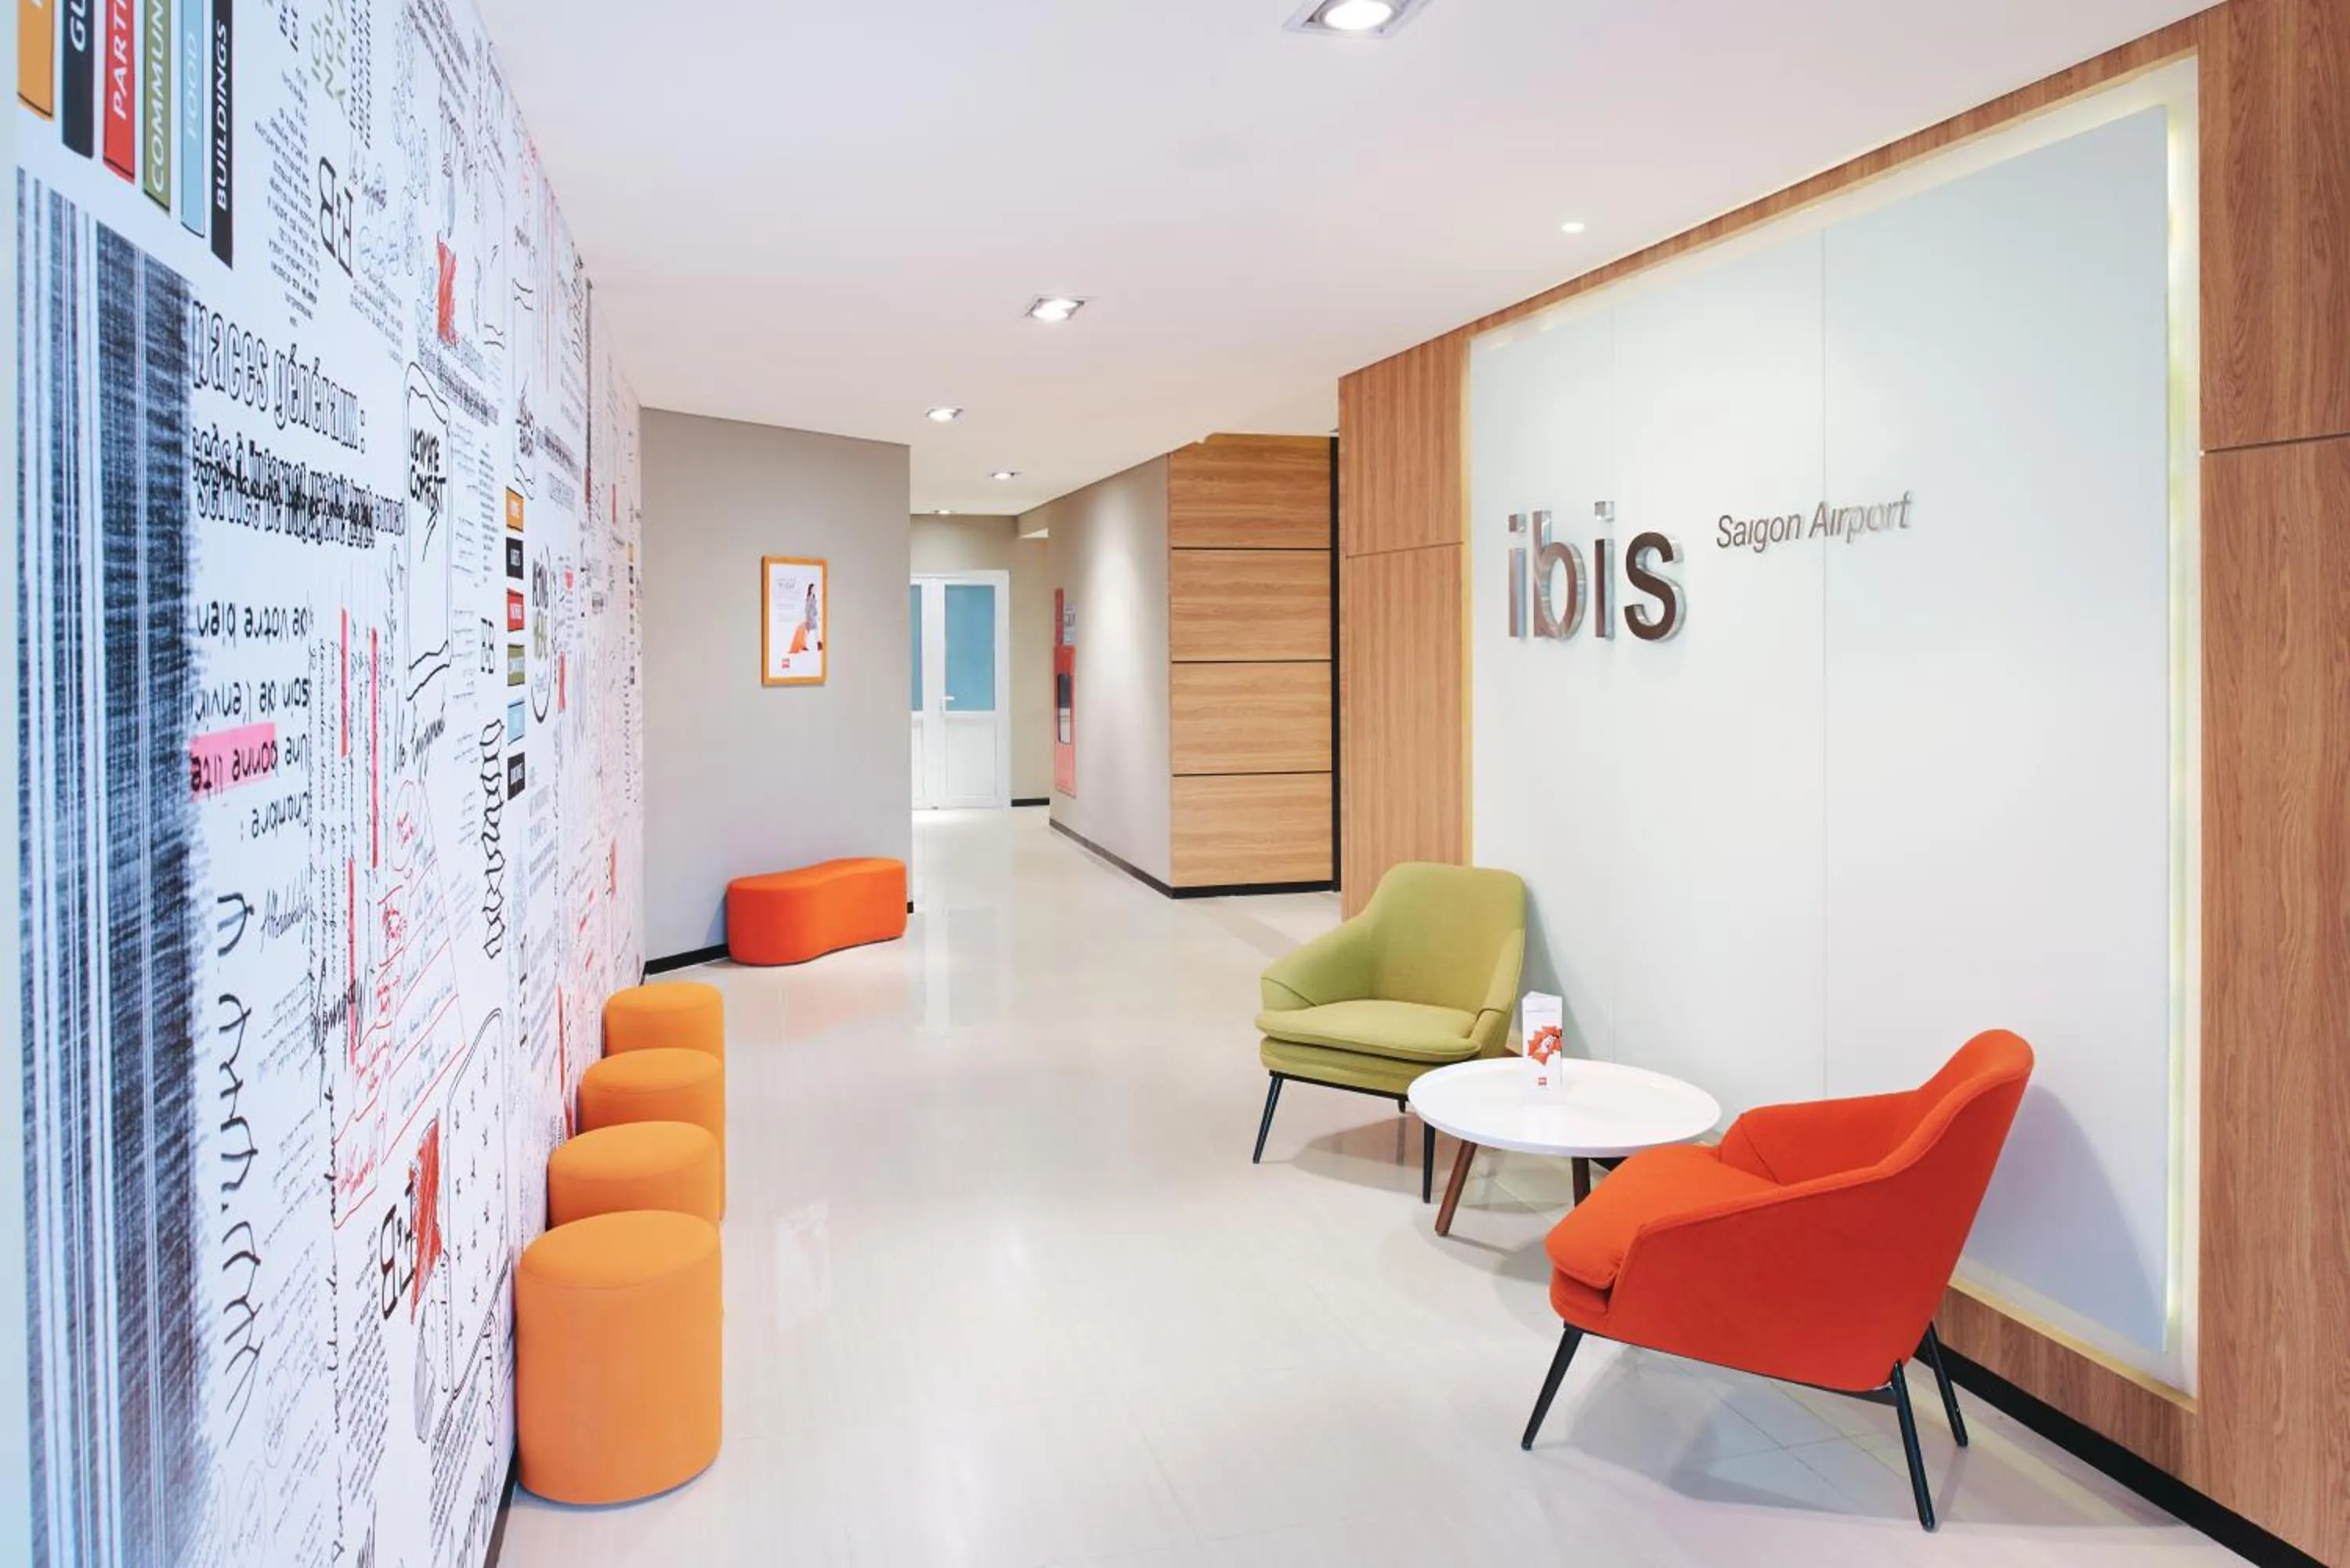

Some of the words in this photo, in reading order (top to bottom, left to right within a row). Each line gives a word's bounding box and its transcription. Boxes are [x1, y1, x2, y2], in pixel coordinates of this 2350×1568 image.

[215, 20, 228, 212] BUILDINGS
[1508, 500, 1687, 642] ibis
[1716, 512, 1801, 554] Saigon
[1808, 490, 1914, 544] Airport
[192, 684, 251, 732] l'envir
